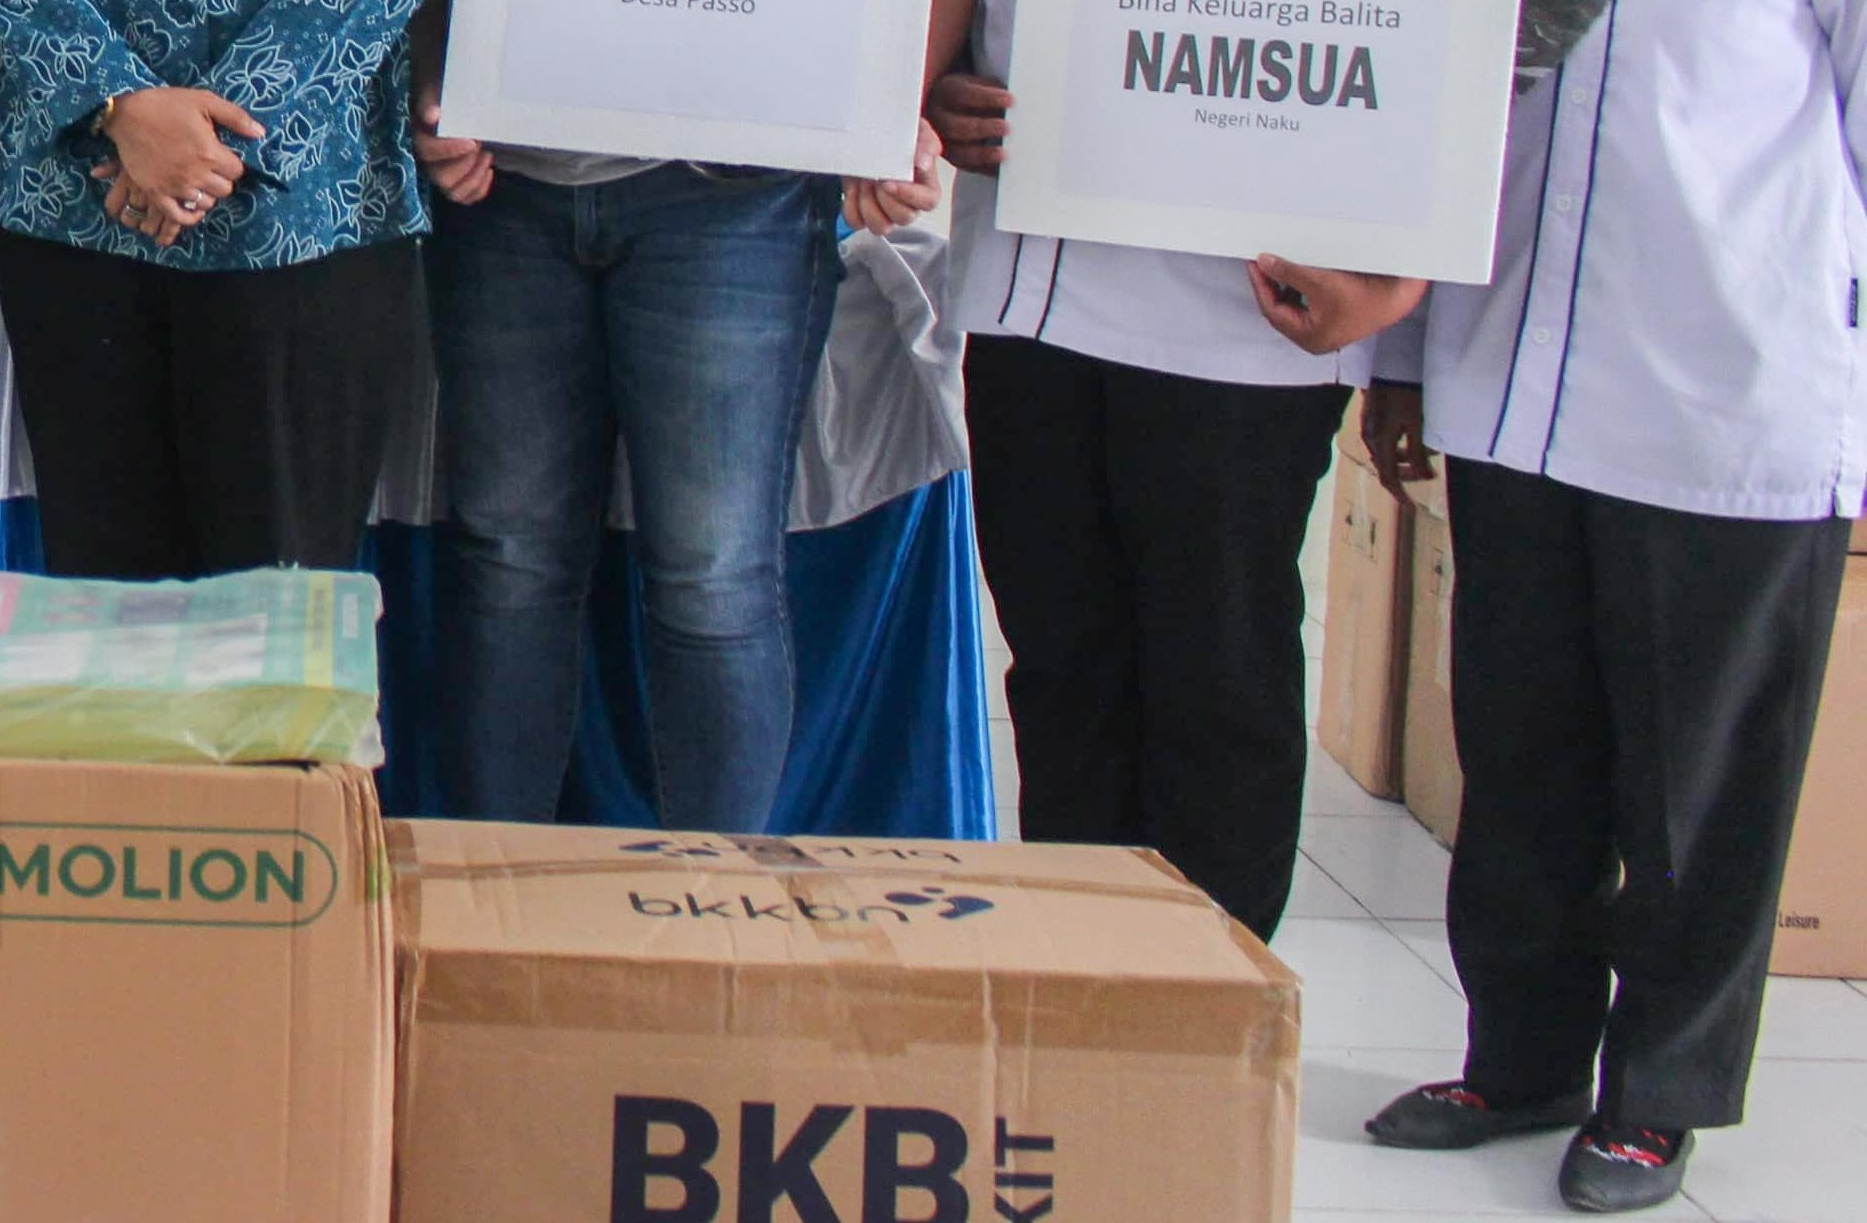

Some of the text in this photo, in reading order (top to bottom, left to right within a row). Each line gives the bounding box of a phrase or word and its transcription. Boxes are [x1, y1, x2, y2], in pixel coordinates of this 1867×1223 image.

[1320, 0, 1401, 28] Balita
[1122, 28, 1379, 110] NAMSUA
[1194, 108, 1301, 132] Negeri Naku
[627, 890, 911, 923] bkkbn
[610, 1093, 970, 1223] BKB
